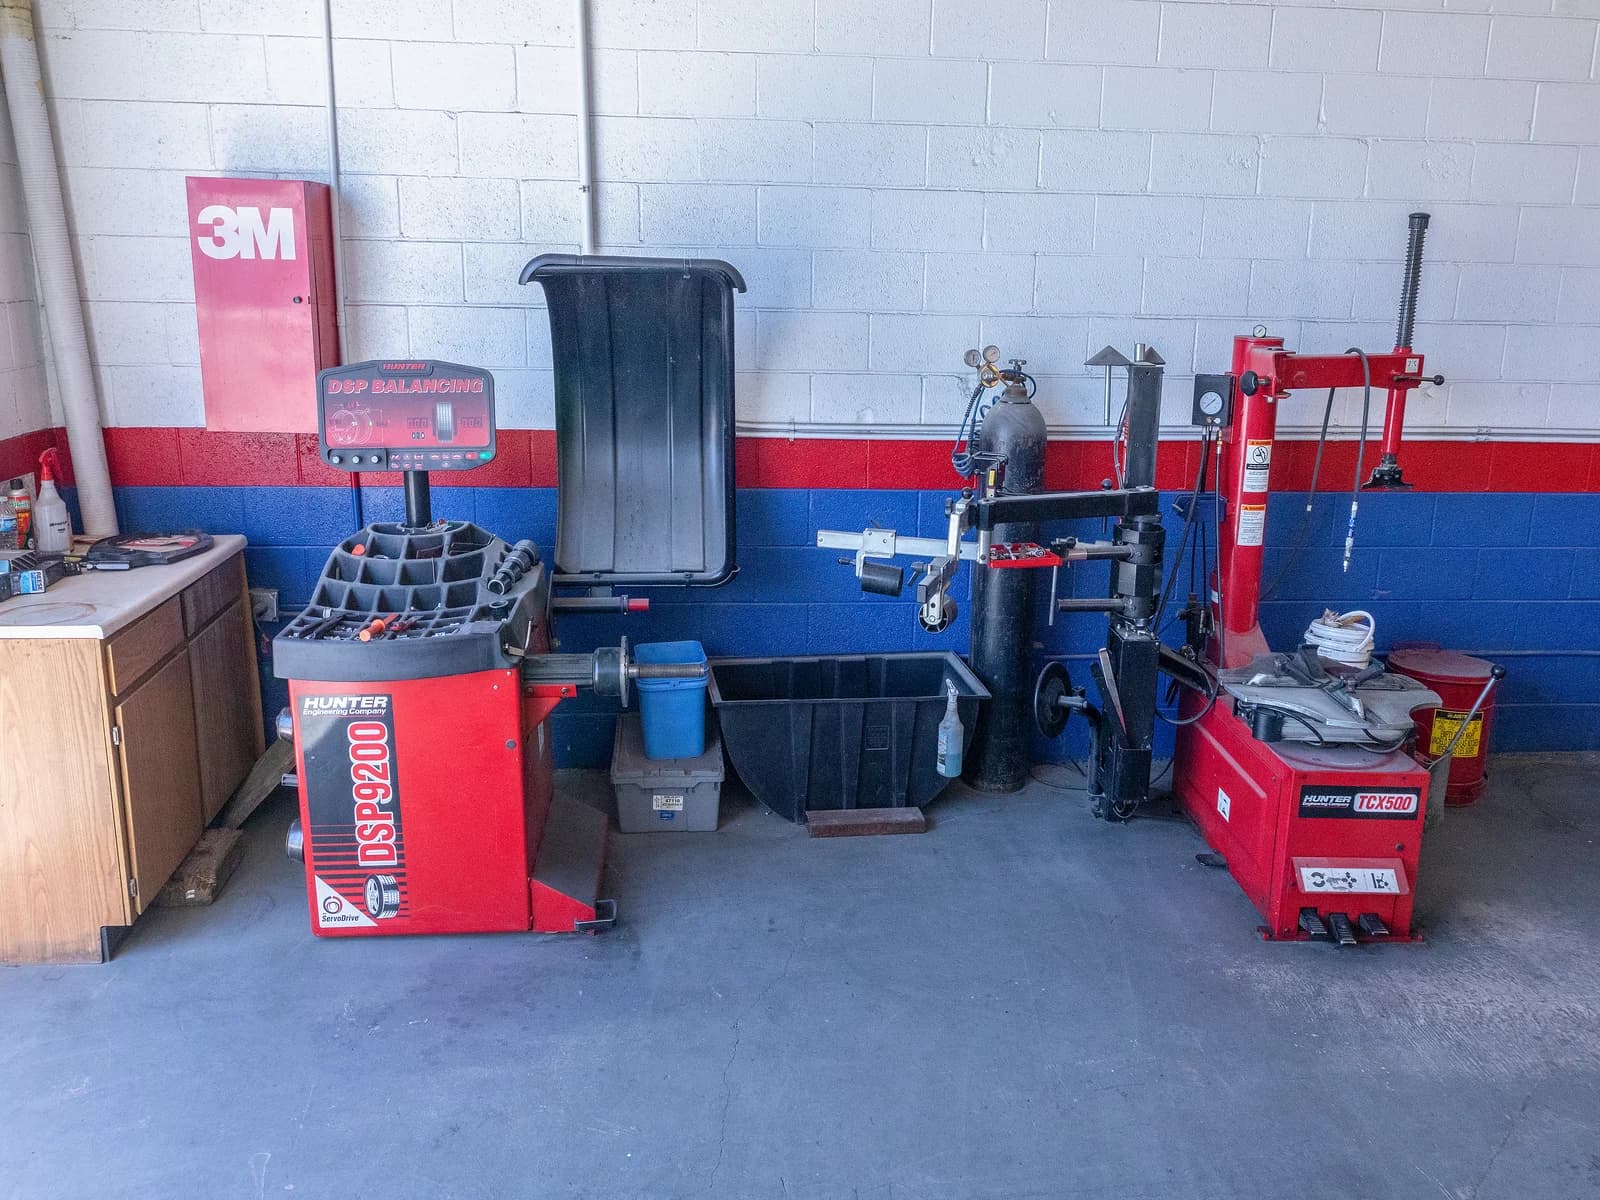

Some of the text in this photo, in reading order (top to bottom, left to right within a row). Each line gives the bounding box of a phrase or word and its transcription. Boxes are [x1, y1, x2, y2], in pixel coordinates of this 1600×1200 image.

[197, 205, 296, 260] 3M
[328, 378, 484, 394] DSP BALANCING
[303, 696, 388, 709] HUNTER
[303, 708, 387, 716] Engineering Company
[347, 721, 398, 866] DSP9200
[1303, 795, 1352, 803] HUNTER
[1358, 795, 1413, 811] TCX500
[321, 914, 360, 922] ServoDrive
